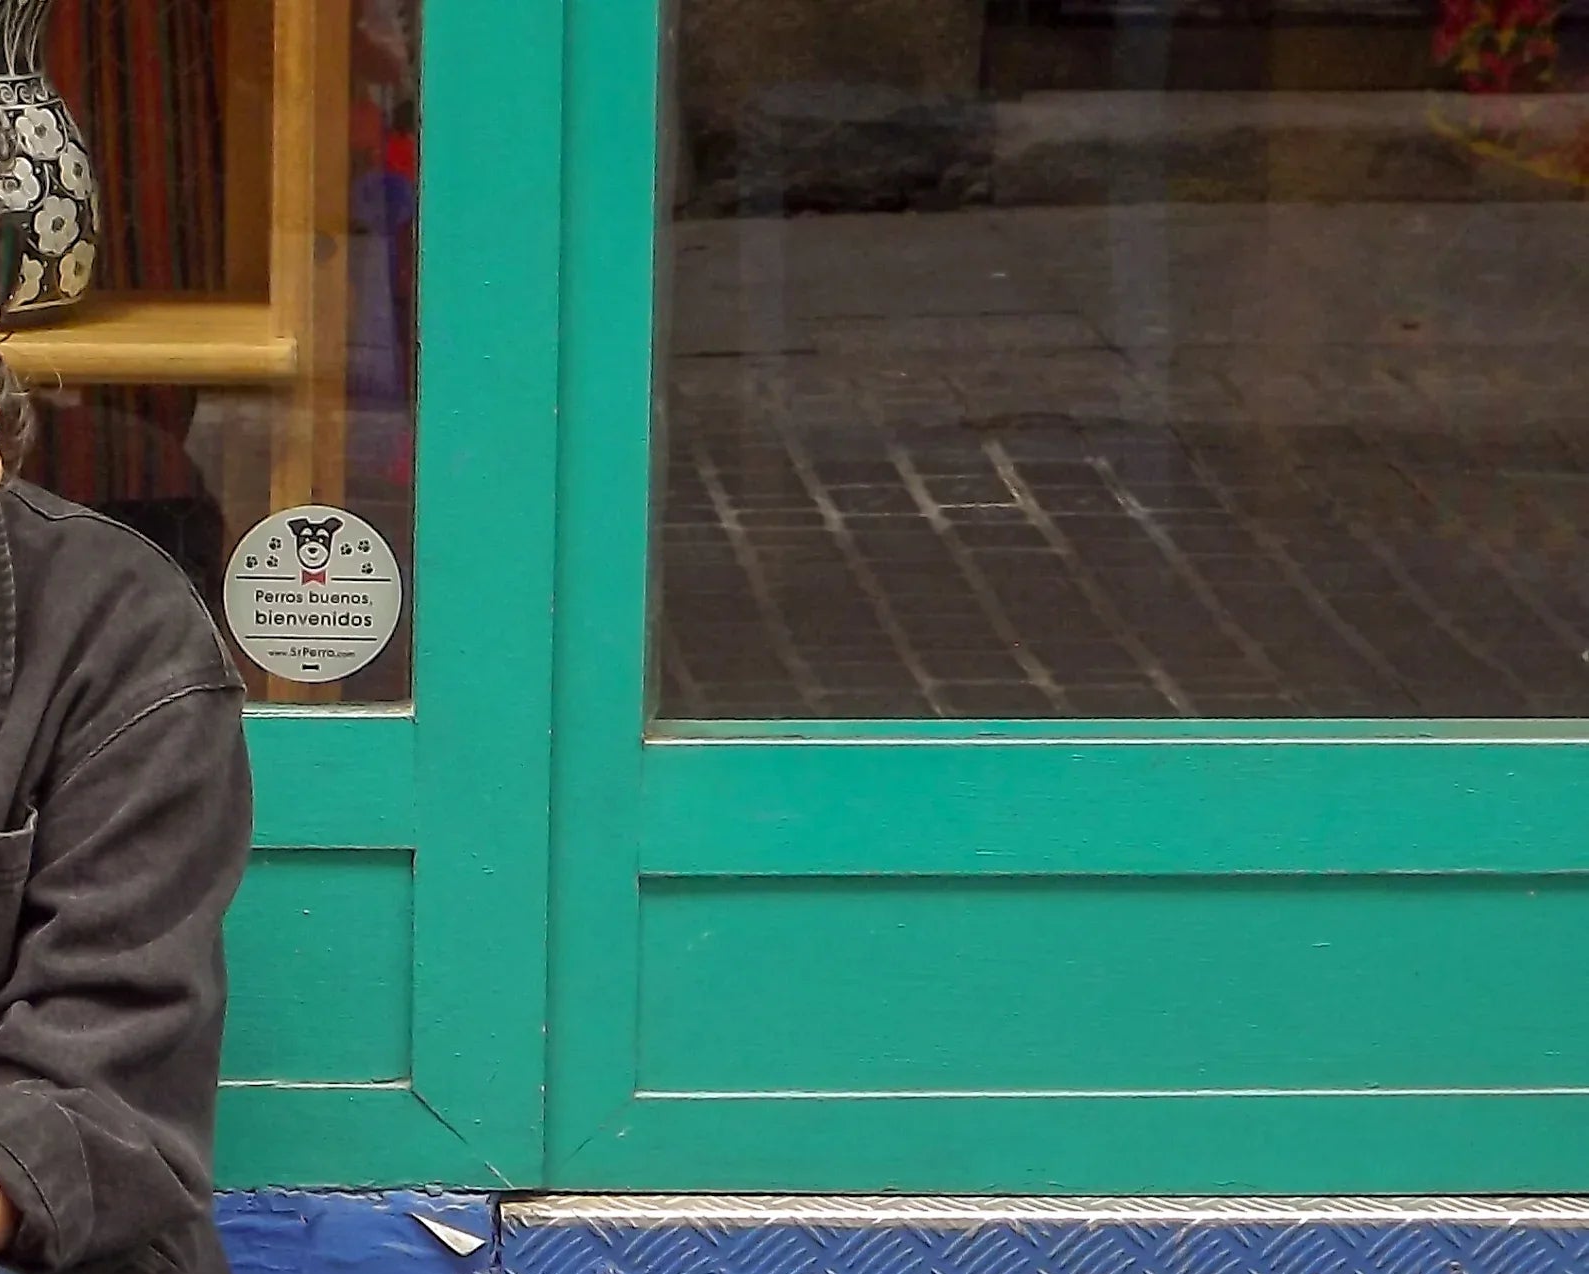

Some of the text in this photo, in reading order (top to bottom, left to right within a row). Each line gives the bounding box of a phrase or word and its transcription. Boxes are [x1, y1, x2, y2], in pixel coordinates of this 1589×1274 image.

[255, 590, 373, 606] Perros buenos,
[255, 609, 373, 627] bienvenidos
